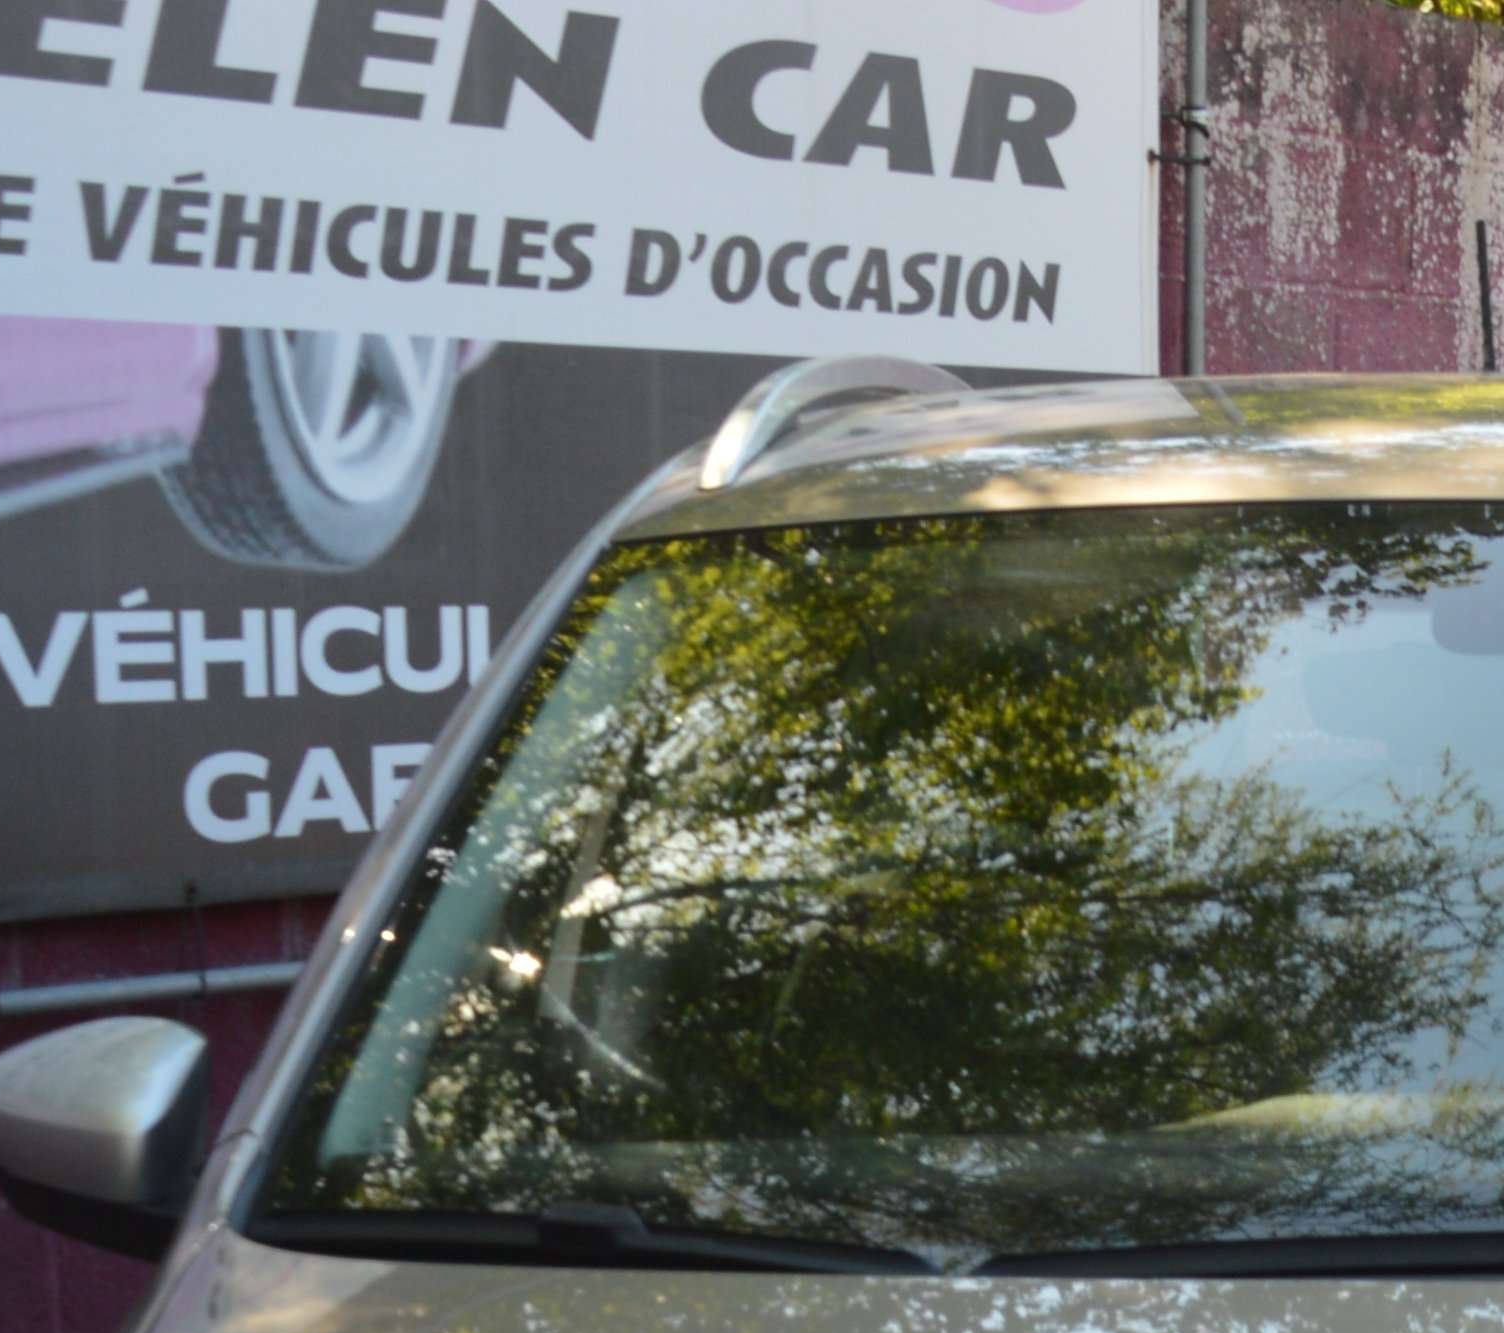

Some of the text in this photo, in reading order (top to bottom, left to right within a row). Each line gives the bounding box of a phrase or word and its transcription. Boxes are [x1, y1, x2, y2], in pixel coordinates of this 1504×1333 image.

[700, 39, 1077, 189] CAR
[78, 171, 596, 293] VÉHICULES
[624, 228, 1061, 324] D'OCCASION
